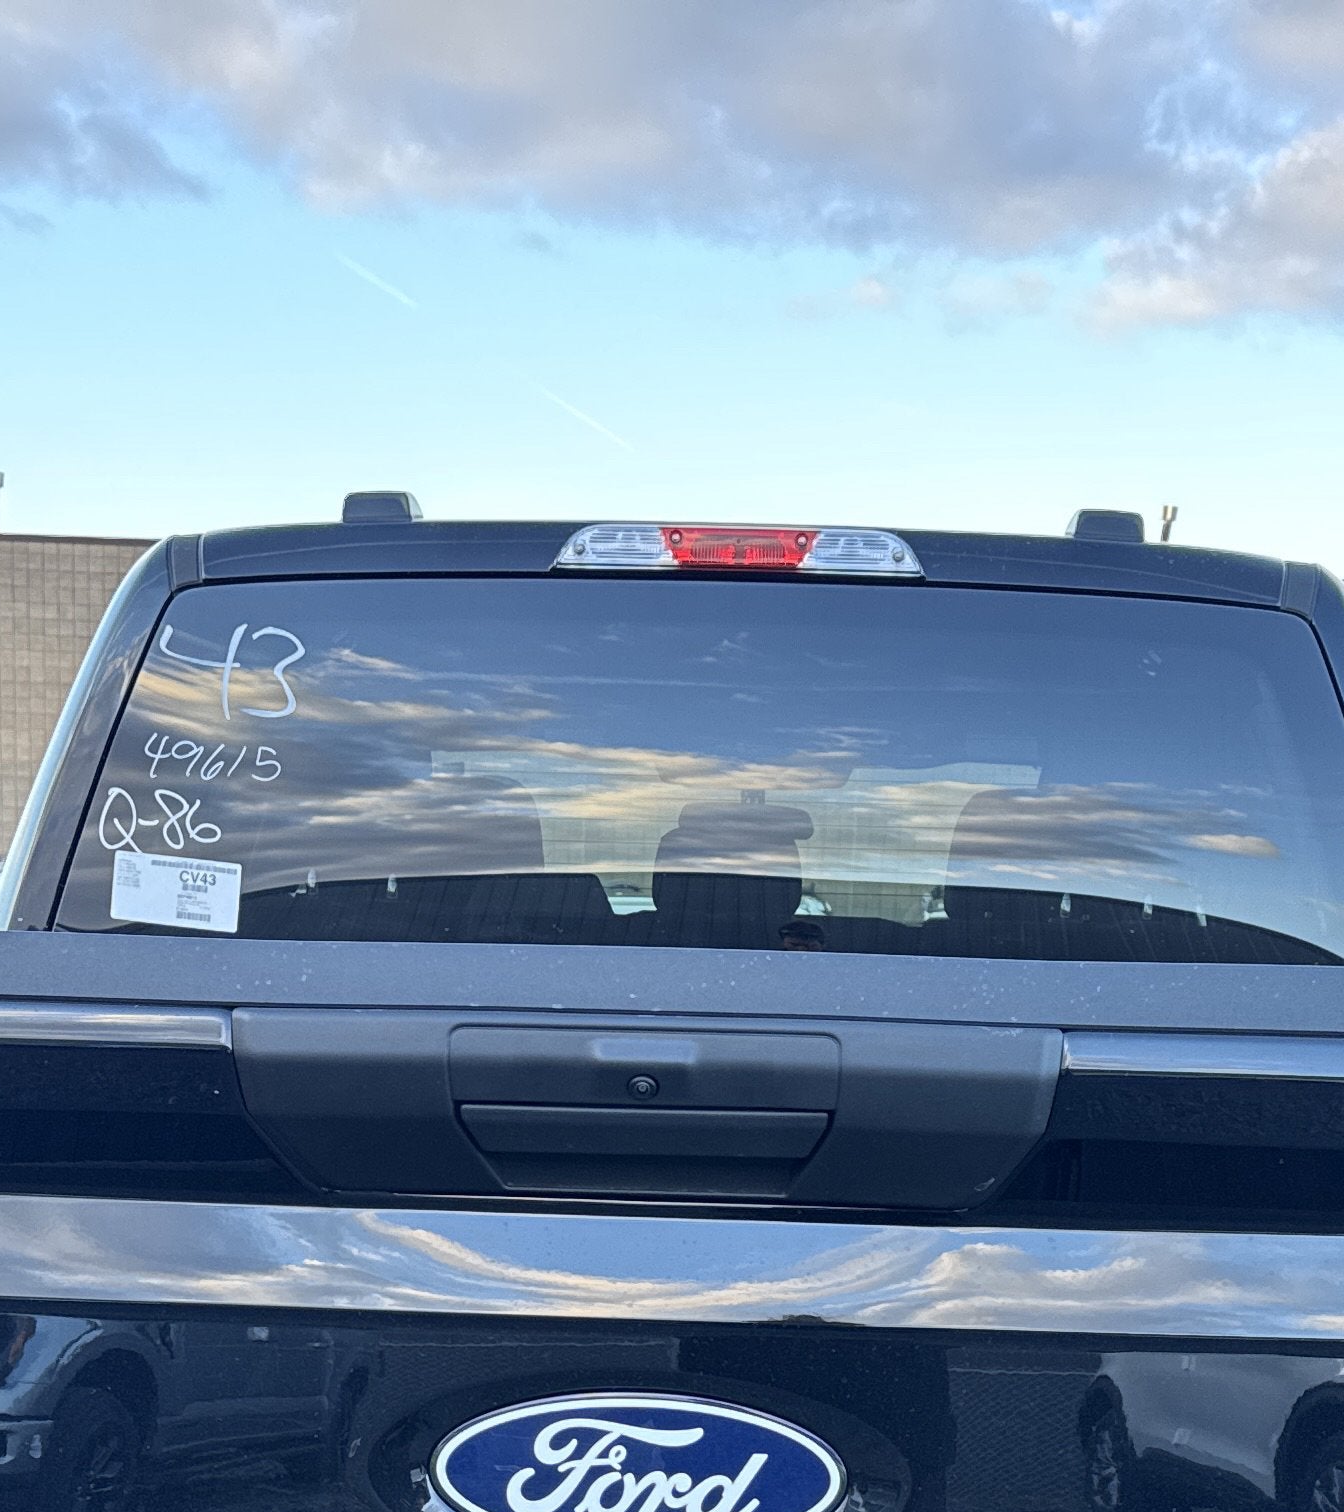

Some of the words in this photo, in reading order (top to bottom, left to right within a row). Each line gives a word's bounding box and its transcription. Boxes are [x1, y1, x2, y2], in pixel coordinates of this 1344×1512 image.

[160, 623, 305, 720] 43
[144, 732, 282, 782] 49615
[98, 787, 222, 852] Q-86
[179, 870, 217, 886] CV43
